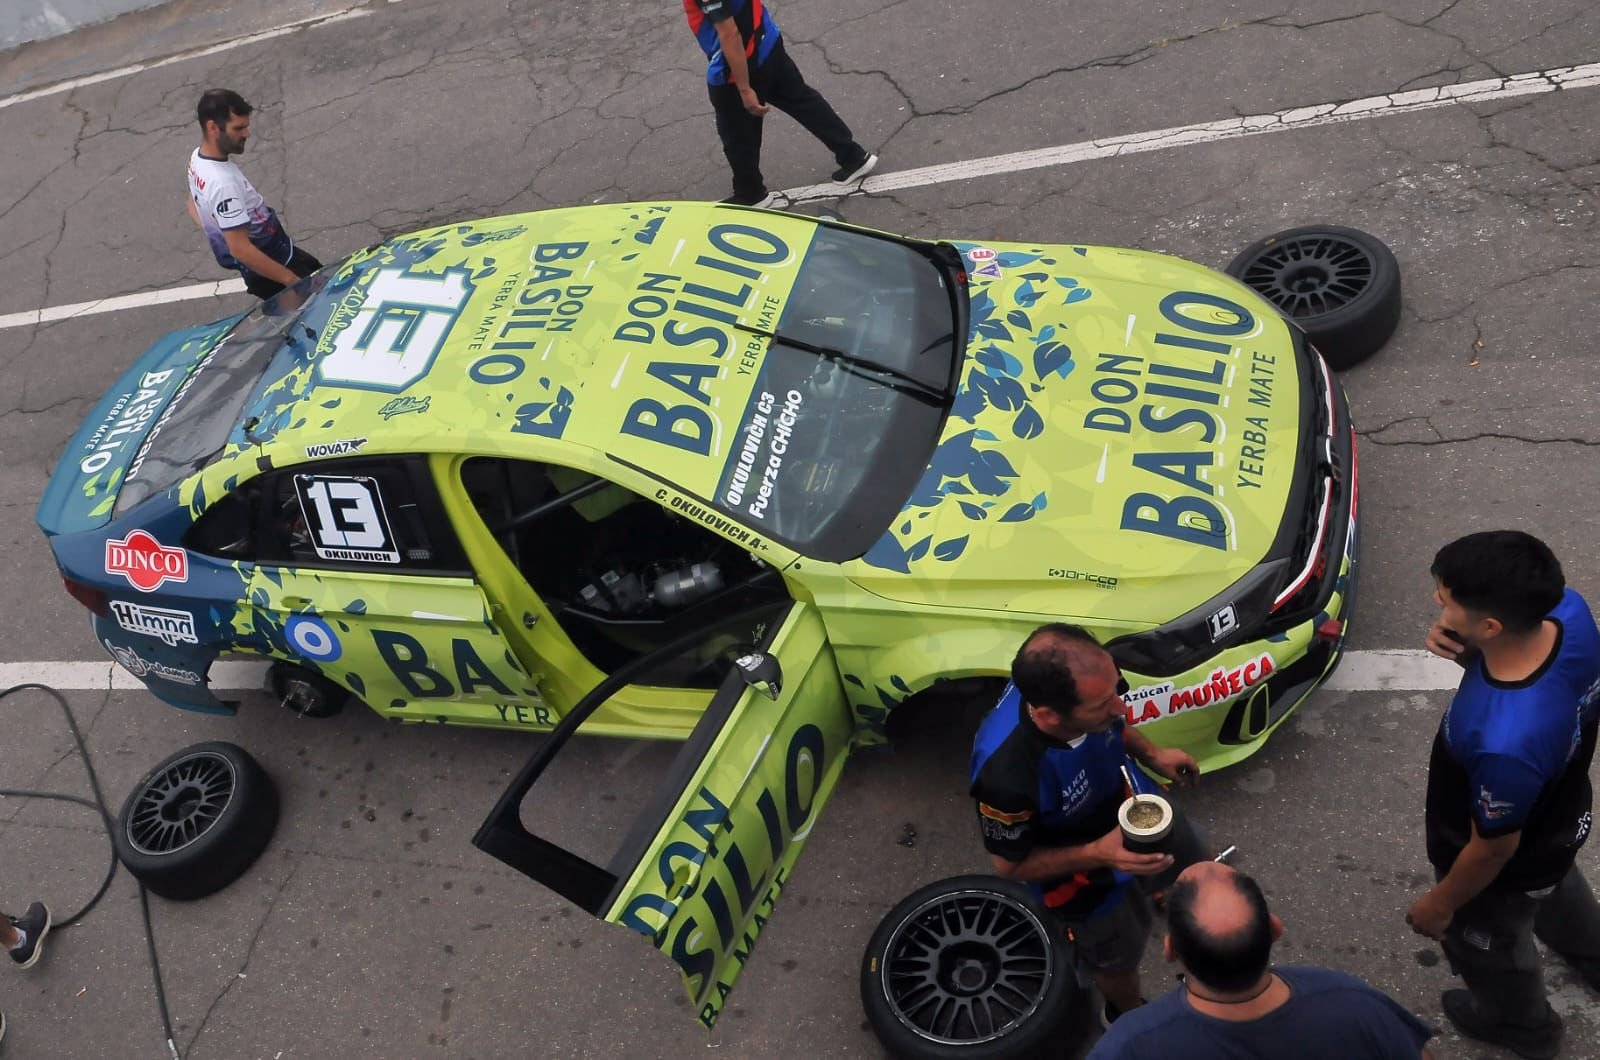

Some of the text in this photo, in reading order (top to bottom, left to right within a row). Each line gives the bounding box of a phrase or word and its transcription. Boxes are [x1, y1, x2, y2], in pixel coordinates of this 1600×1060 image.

[469, 241, 589, 385] BASILIO
[491, 271, 522, 311] YERBA
[546, 285, 594, 331] DON
[613, 272, 682, 345] DON
[318, 267, 470, 390] 13
[468, 315, 497, 351] MATE
[619, 224, 790, 457] BASILIO
[737, 295, 780, 376] YERBA MATE
[81, 368, 174, 474] BASILIO
[85, 392, 132, 450] YERBA MATE
[130, 397, 164, 433] DON
[1083, 352, 1145, 434] DON
[1119, 290, 1255, 552] BASILIO
[1237, 351, 1276, 489] YERBA MATE
[726, 391, 775, 506] OKULOVICH C3
[748, 389, 802, 519] Fuerza CHICHO
[306, 481, 386, 549] 13
[655, 488, 769, 551] C. OKULOVICH A+
[111, 547, 182, 574] DINCO
[324, 549, 392, 562] OKULOVICH
[112, 602, 195, 644] Himpa
[1211, 605, 1237, 637] 13
[1123, 684, 1170, 703] Azúcar
[1126, 656, 1274, 726] LA MUÑECA
[618, 786, 734, 948] DON
